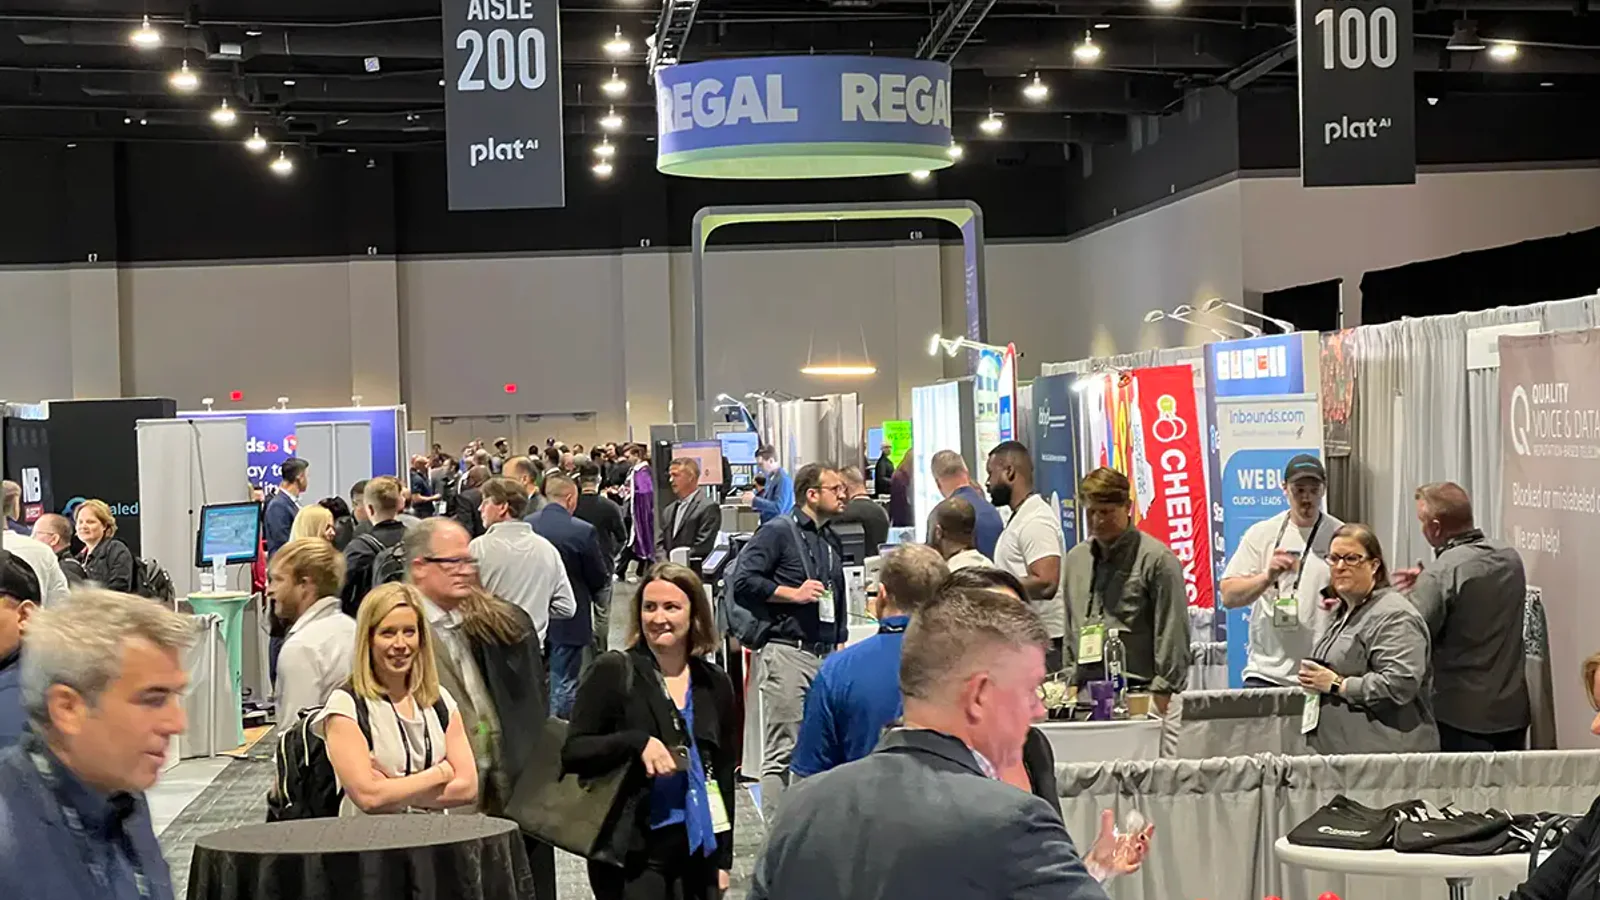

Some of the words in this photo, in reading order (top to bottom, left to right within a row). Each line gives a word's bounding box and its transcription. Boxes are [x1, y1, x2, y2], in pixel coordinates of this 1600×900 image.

[467, 0, 534, 21] AISLE
[456, 28, 546, 91] 200
[1314, 6, 1398, 70] 100
[661, 73, 799, 135] REGAL
[1532, 383, 1569, 404] QUALITY
[1532, 410, 1562, 438] VOICE
[1574, 410, 1600, 438] DATA
